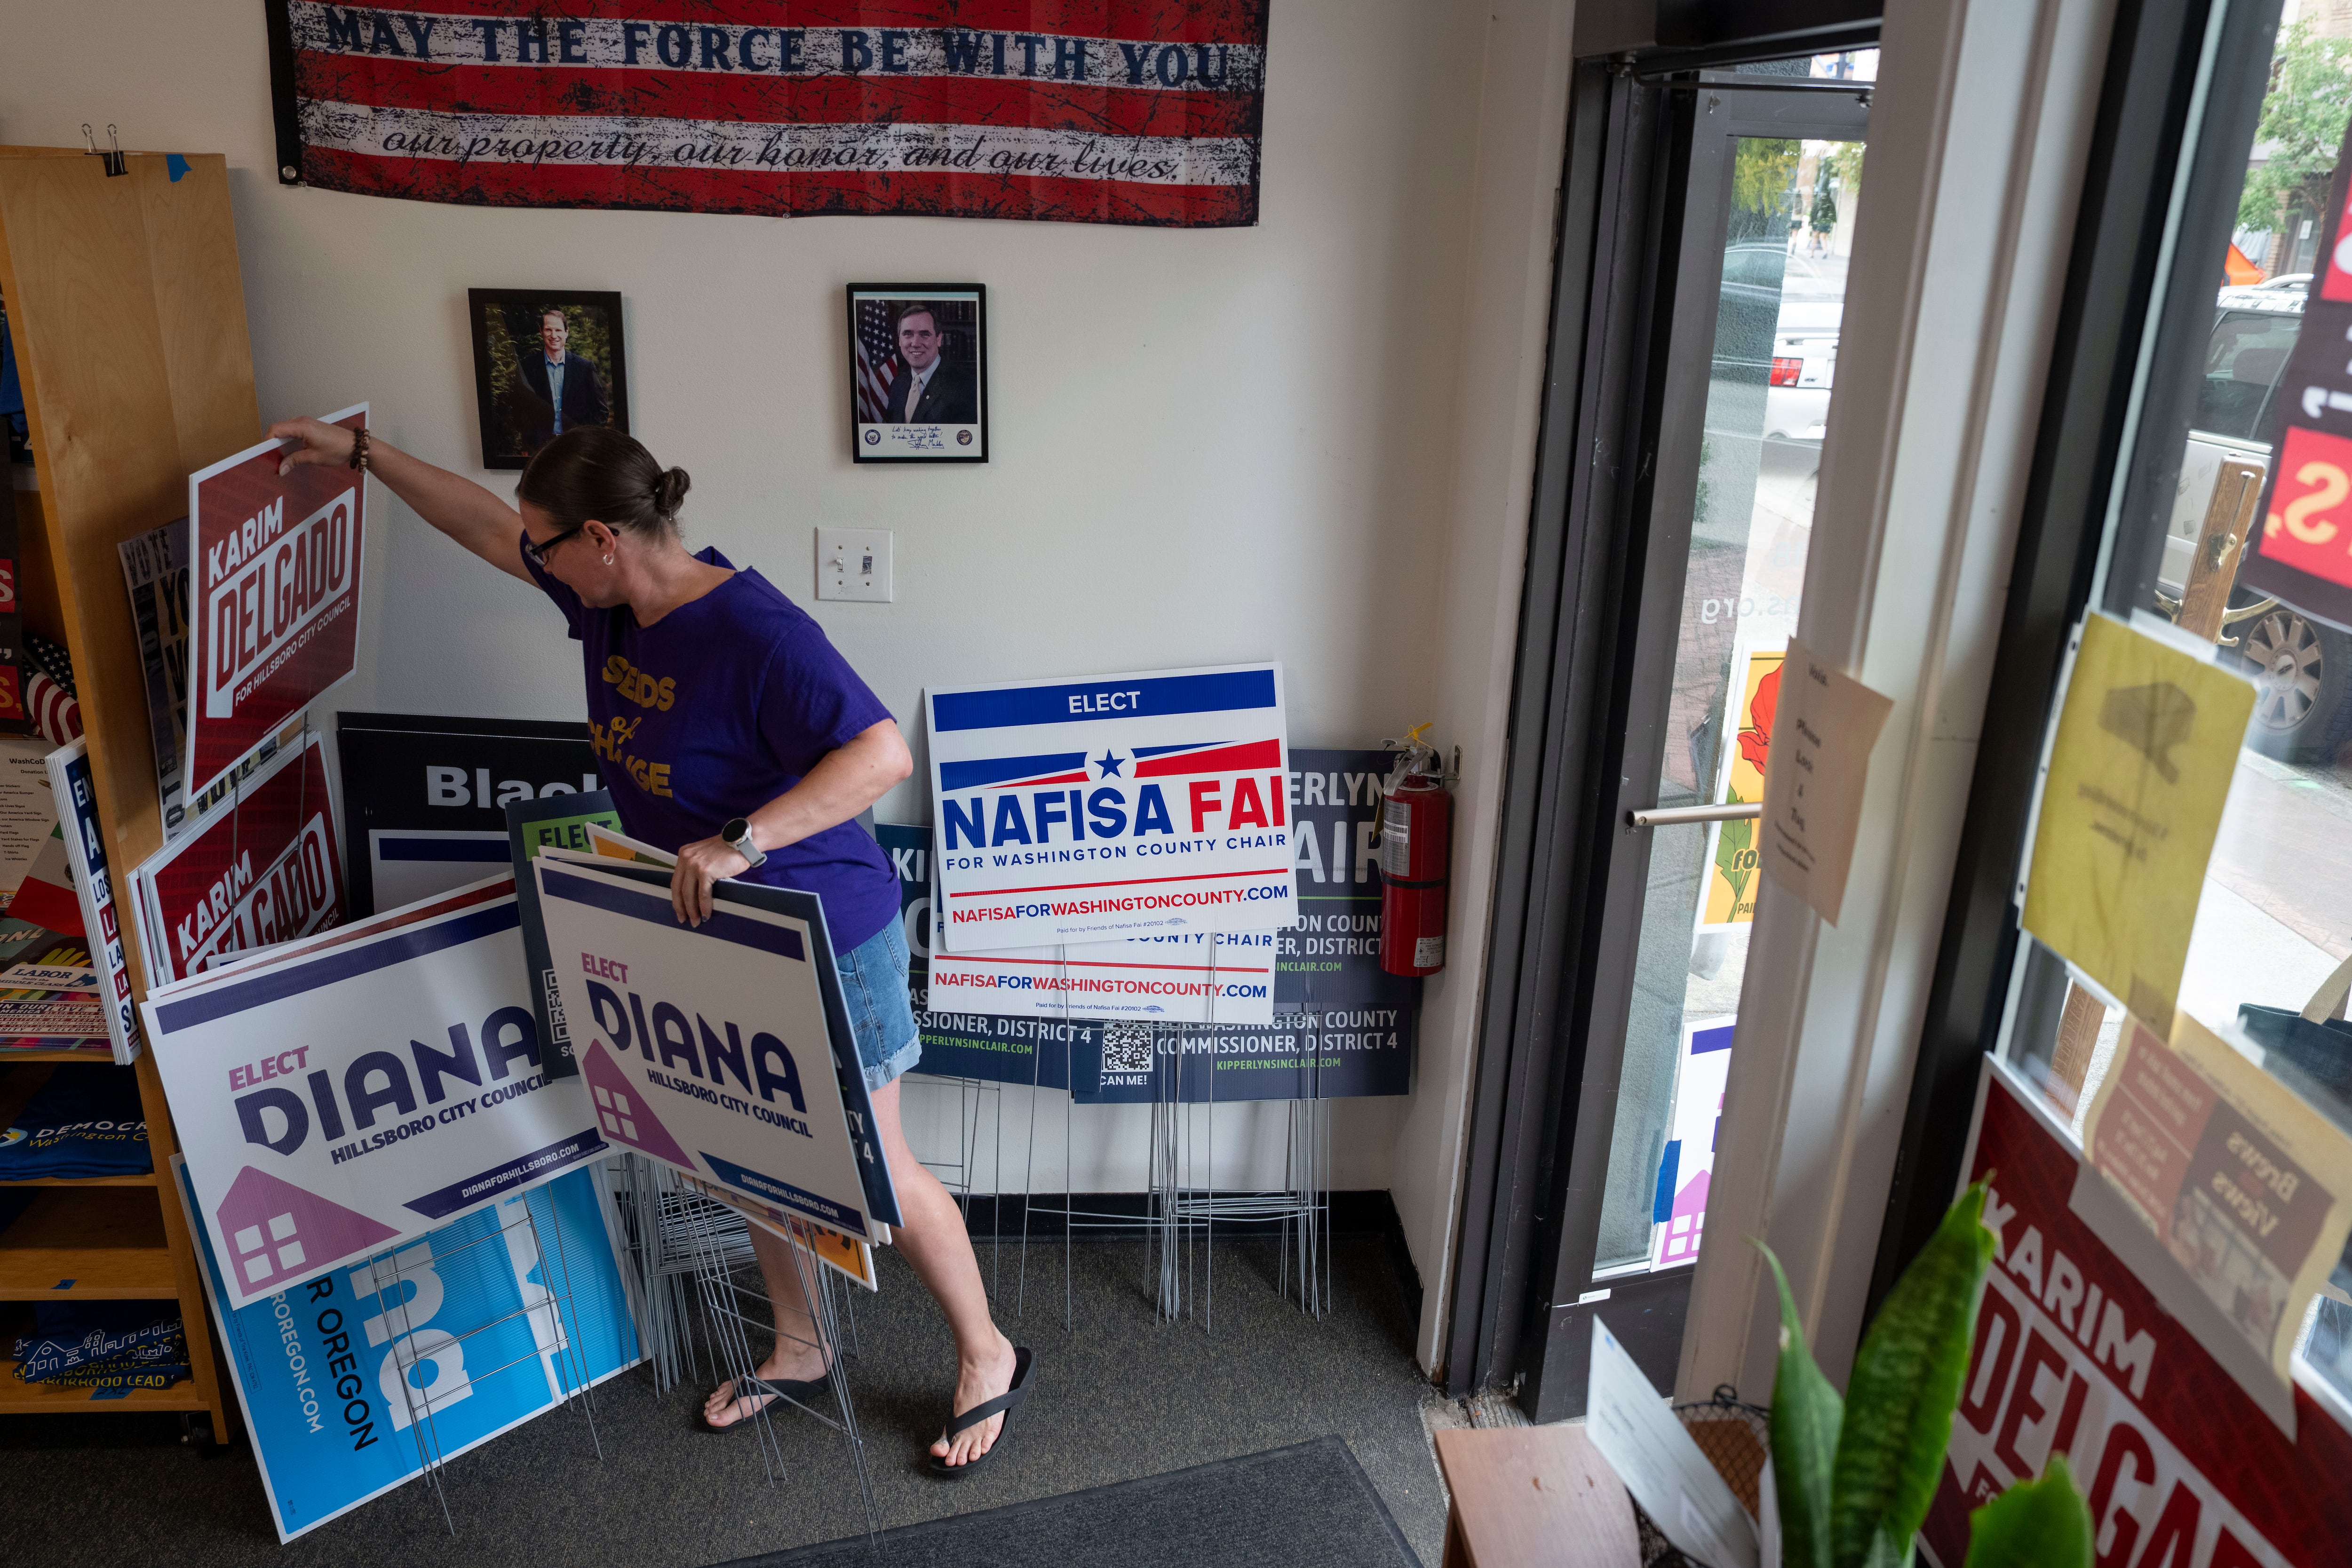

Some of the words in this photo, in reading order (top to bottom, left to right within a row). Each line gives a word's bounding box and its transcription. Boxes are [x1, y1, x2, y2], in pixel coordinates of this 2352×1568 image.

[324, 6, 438, 59] MAY
[471, 19, 588, 63] THE
[621, 24, 805, 73] FORCE
[845, 30, 910, 73] BE
[941, 30, 1087, 81] WITH
[1120, 42, 1229, 88] YOU
[382, 131, 457, 157] our
[457, 133, 658, 172] property,
[675, 142, 750, 164] our
[755, 130, 889, 168] honor,
[904, 135, 985, 168] and
[989, 150, 1060, 171] our
[1072, 143, 1177, 180] lives.
[123, 529, 170, 586] VOTE
[210, 495, 282, 588] KARIM
[216, 503, 347, 692] DELGADO
[235, 682, 252, 707] FOR
[254, 641, 297, 689] HILLSBORO
[298, 622, 316, 648] CITY
[317, 599, 351, 631] COUNCIL
[1069, 691, 1140, 713] ELECT
[611, 716, 642, 744] of
[1289, 772, 1391, 806] ERLYN
[942, 784, 1174, 851] NAFISA
[1189, 776, 1285, 832] FAI
[946, 857, 983, 870] FOR
[993, 846, 1126, 867] WASHINGTON
[1136, 839, 1216, 856] COUNTY
[1227, 834, 1285, 849] CHAIR
[177, 849, 253, 960] KARIM
[953, 885, 1287, 923] NAFISAFORWASHINGTONCOUNTY.COM
[1214, 933, 1272, 946] CHAIR
[1327, 915, 1382, 932] COUN
[12, 969, 73, 979] LABOR
[581, 952, 628, 984] ELECT
[935, 972, 1266, 997] NAFISAFORWASHINGTONCOUNTY.COM
[997, 1018, 1077, 1042] DISTRICT
[1081, 1027, 1091, 1043] 4
[1326, 1010, 1397, 1028] COUNTY
[586, 979, 807, 1114] DIANA
[920, 1035, 1033, 1055] PPERLYNSINCLAIR.COM
[1157, 1035, 1300, 1055] COMMISSIONER,
[1306, 1033, 1383, 1051] DISTRICT
[1387, 1032, 1397, 1049] 4
[229, 1045, 309, 1092] ELECT
[234, 1006, 541, 1156] DIANA
[1100, 1075, 1124, 1085] CAN
[1127, 1075, 1147, 1085] ME!
[1217, 1058, 1341, 1070] KIPPERLYNSINCLAIR.COM
[331, 1114, 436, 1165] HILLSBORO
[438, 1098, 478, 1126] CITY
[479, 1073, 552, 1111] COUNCIL
[647, 1068, 718, 1105] HILLSBORO
[721, 1096, 748, 1116] CITY
[753, 1105, 812, 1138] COUNCIL
[29, 1131, 126, 1147] Washington
[36, 1121, 147, 1138] DEMOCR
[462, 1143, 580, 1198] DIANAFORHILLSBORO.COM
[864, 1142, 874, 1164] 4
[741, 1174, 839, 1218] DIANAFORHILLSBORO.COM
[1979, 1188, 2158, 1401] KARIM
[127, 1375, 165, 1387] LEAD
[317, 1307, 379, 1453] OREGON
